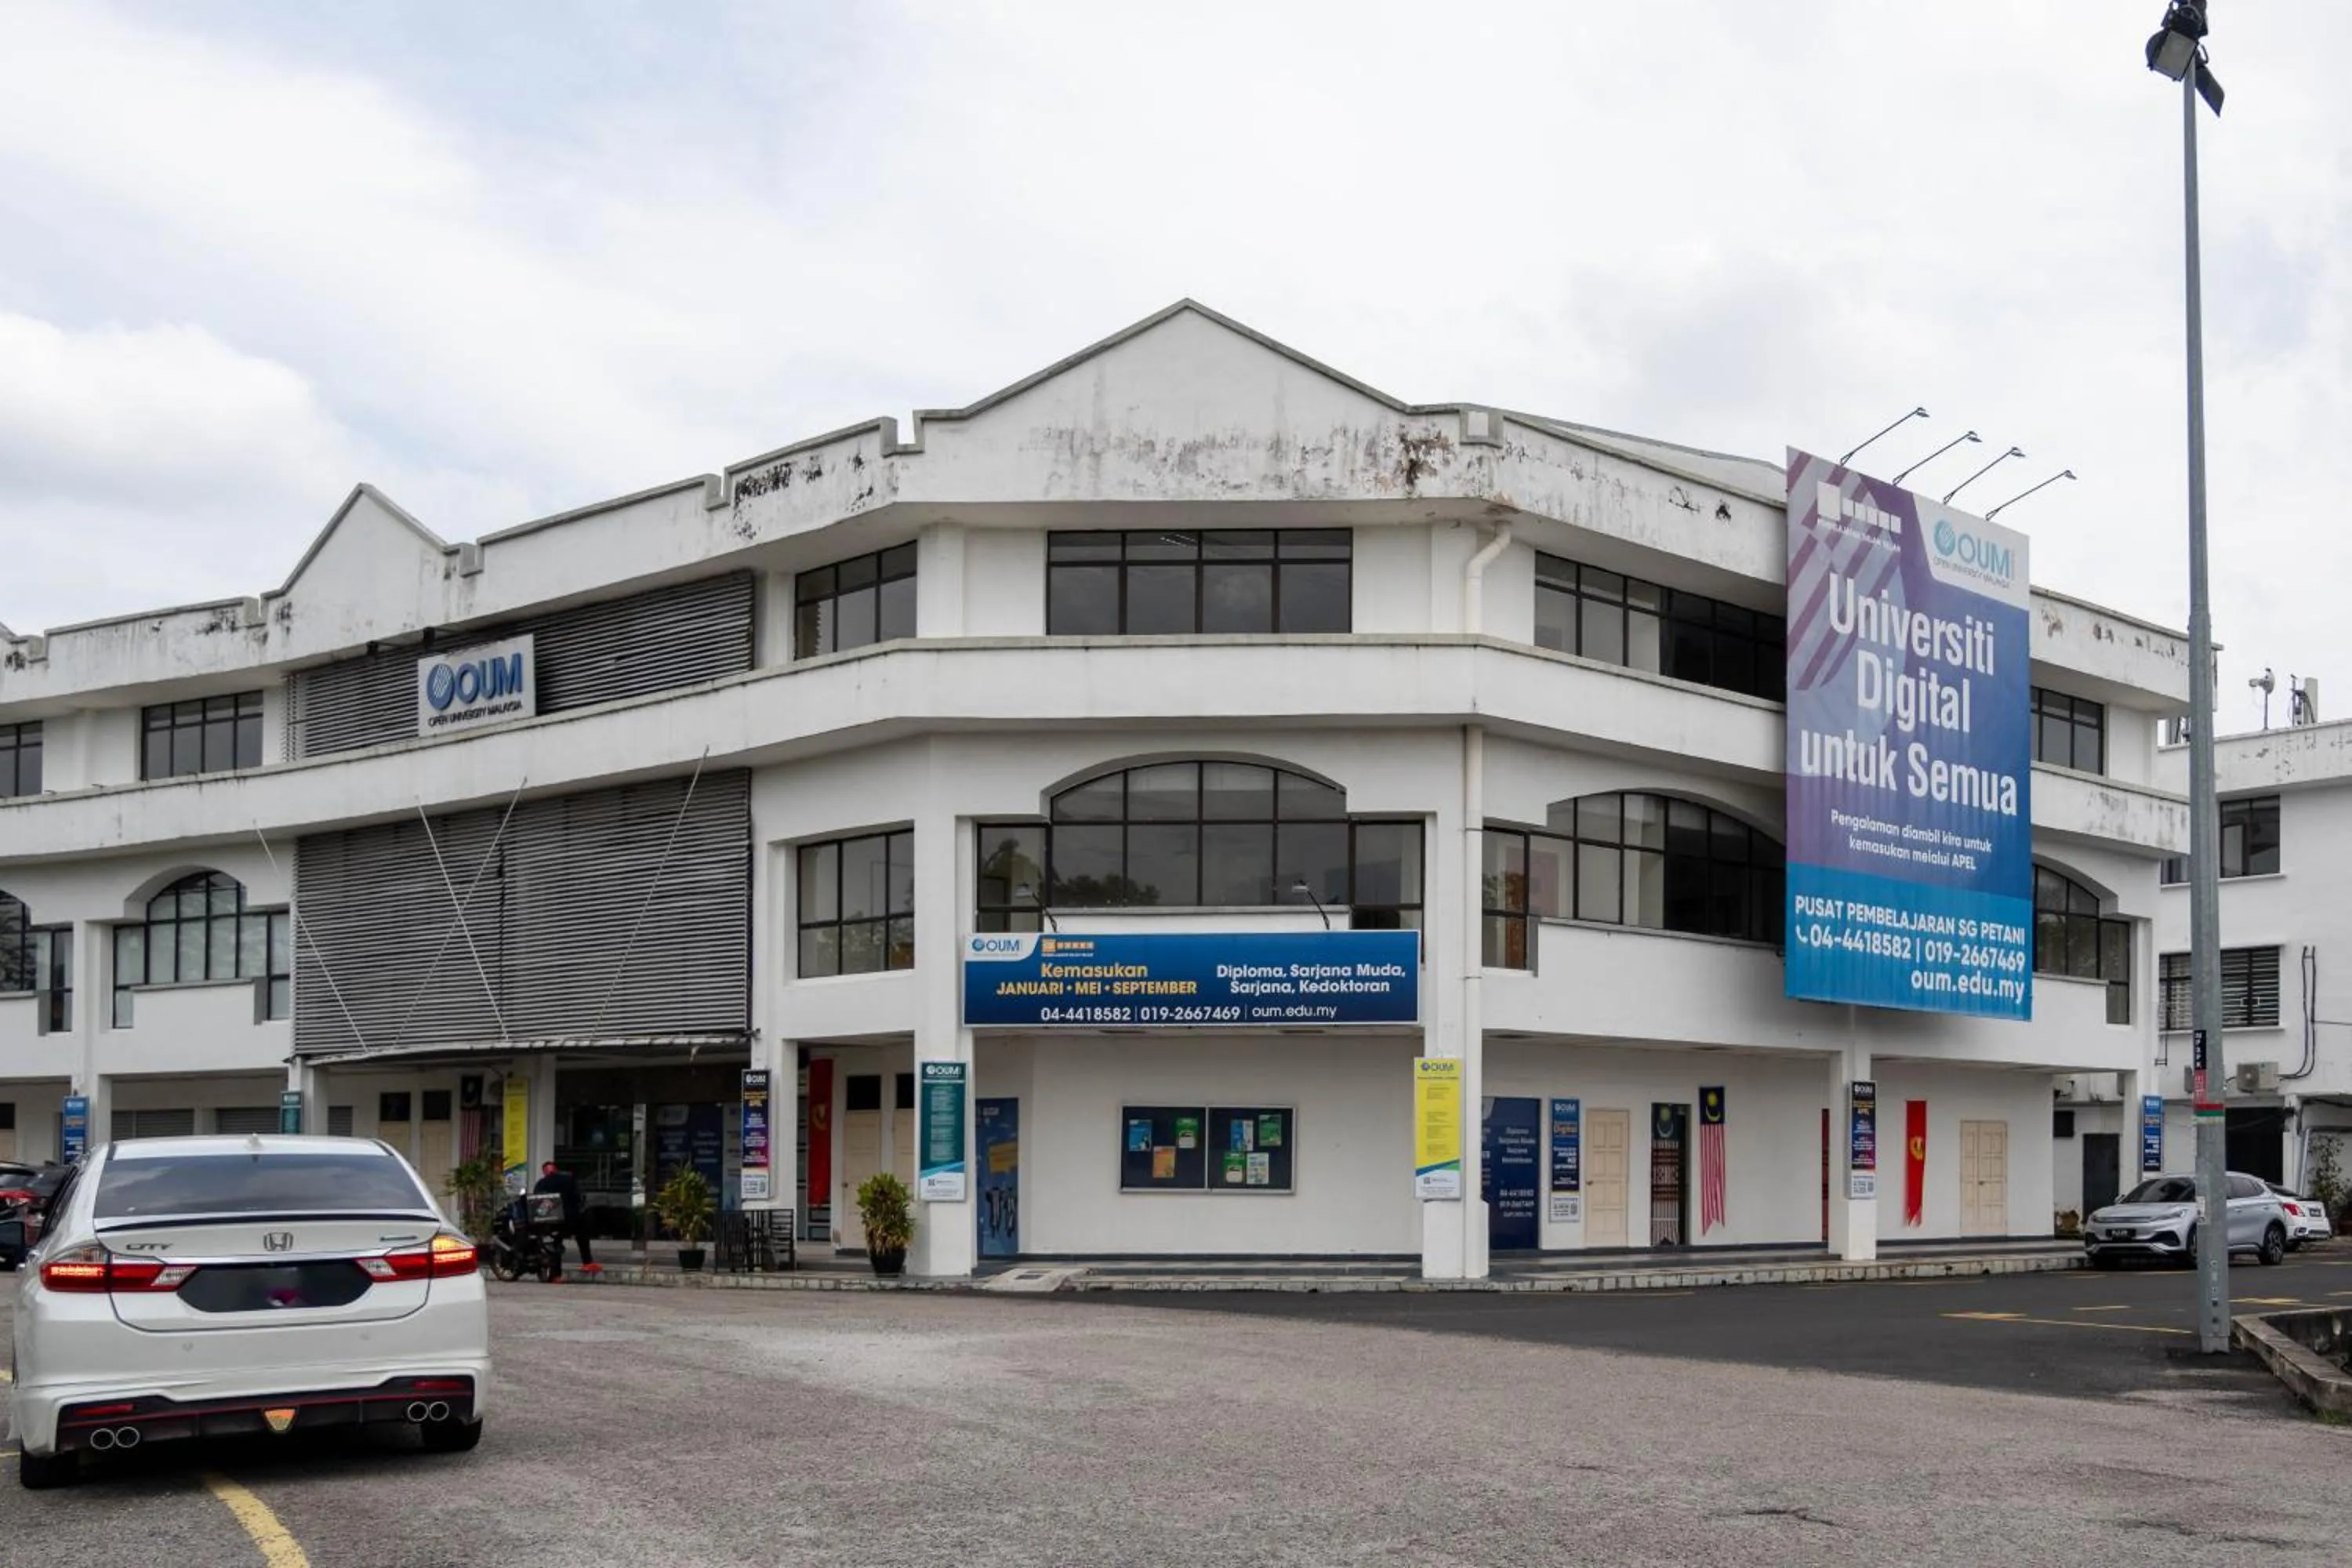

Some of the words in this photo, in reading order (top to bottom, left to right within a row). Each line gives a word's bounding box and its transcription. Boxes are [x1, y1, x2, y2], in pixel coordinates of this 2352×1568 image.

[1958, 533, 2009, 579] OUM
[1829, 572, 1994, 676] Universiti
[456, 652, 523, 704] OUM
[1857, 649, 1970, 733] Digital
[1801, 729, 1898, 792] untuk
[1907, 742, 2017, 816] Semua
[1831, 809, 1899, 837] Pengalaman
[1902, 824, 1940, 844] diambil
[1942, 829, 1962, 848] kira
[1963, 833, 1992, 853] untuk
[1849, 835, 1911, 861] kemasukan
[1912, 849, 1950, 866] melalui
[1951, 853, 1976, 871] APEL
[1795, 895, 1842, 920] PUSAT
[1847, 902, 1955, 936] PEMBELAJARAN
[1958, 920, 1978, 937] SG
[1981, 921, 2025, 946] PETANI
[986, 939, 1019, 952] OUM
[1810, 924, 1911, 960] 04-4418582
[1925, 941, 2025, 972] 019-2667469
[996, 982, 1064, 995] JANUARI
[1075, 982, 1102, 994] MEI
[1112, 981, 1197, 994] SEPTEMBER
[1040, 963, 1148, 978] Kemasukan
[1217, 964, 1287, 979] Diploma,
[1290, 964, 1352, 980] Sarjana
[1356, 963, 1406, 978] Muda,
[1230, 980, 1295, 996] Sarjana,
[1299, 979, 1390, 993] Kedoktoran
[1911, 968, 2025, 1004] oum.edu.my
[1040, 1007, 1131, 1020] 04-4418582
[1141, 1006, 1241, 1020] 019-2667469
[1252, 1005, 1337, 1018] oum.edu.my
